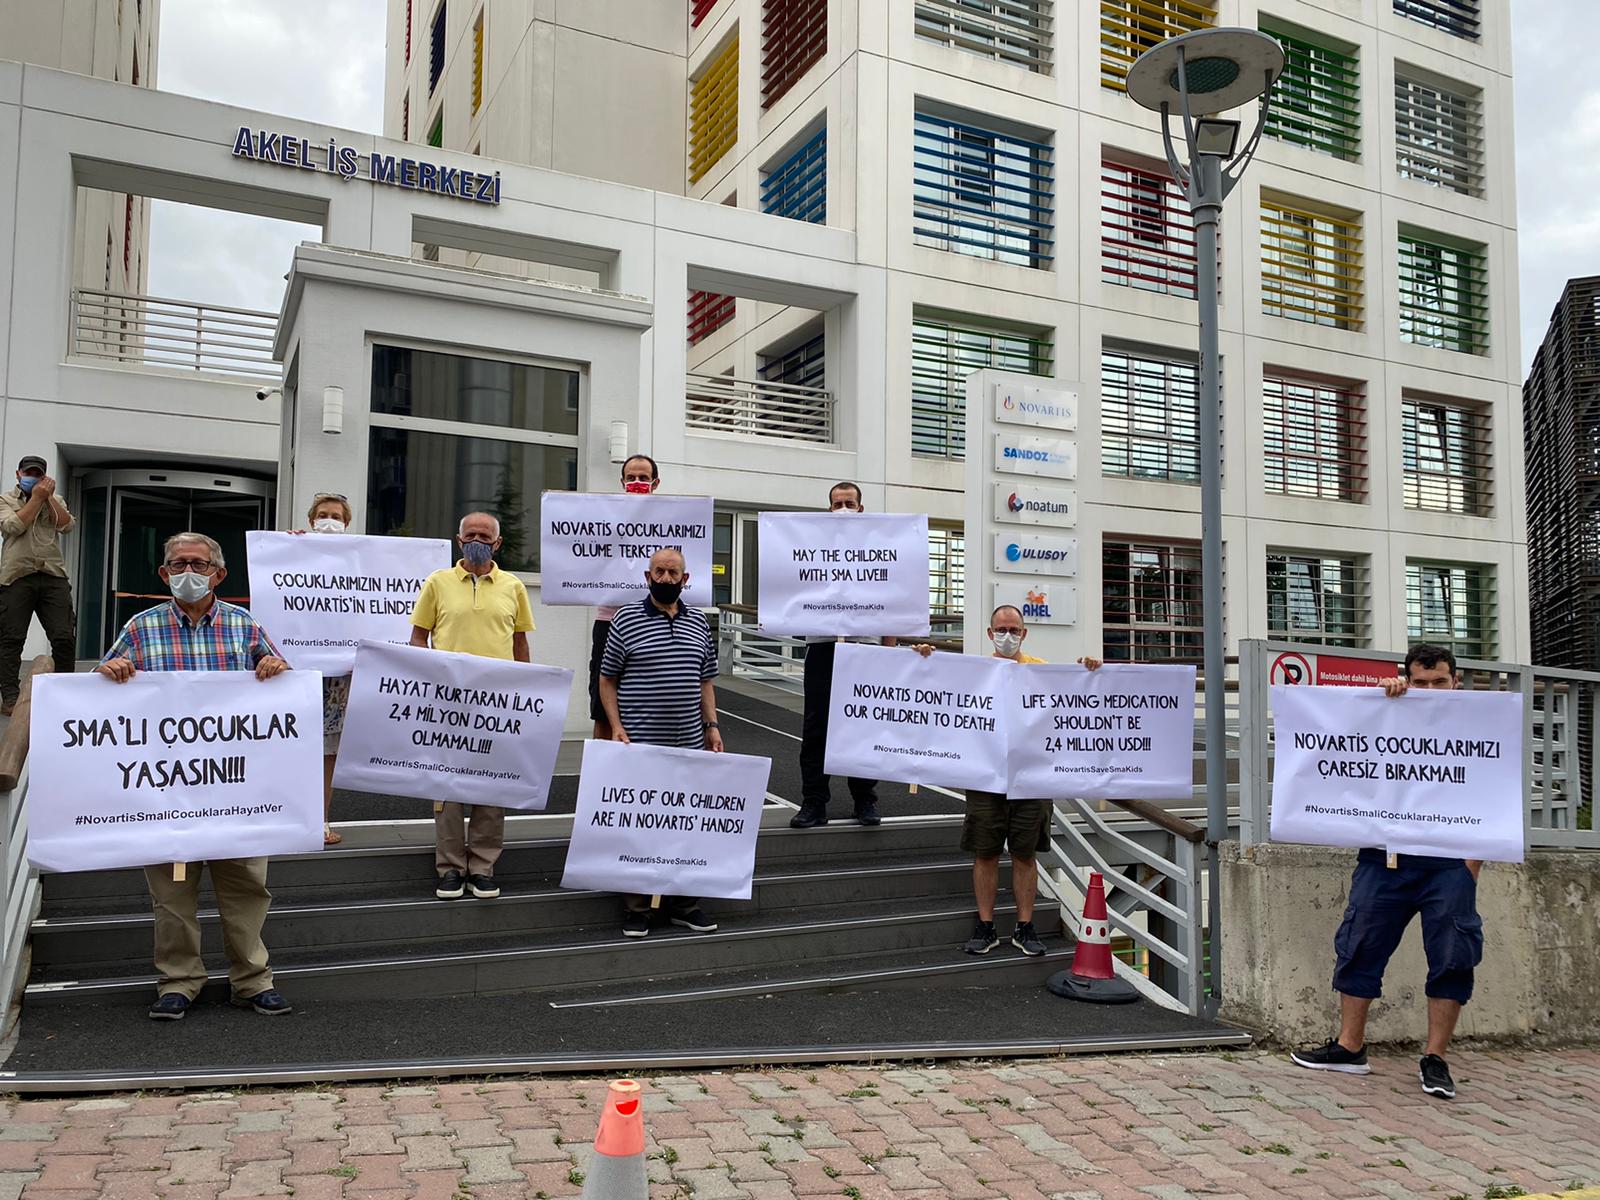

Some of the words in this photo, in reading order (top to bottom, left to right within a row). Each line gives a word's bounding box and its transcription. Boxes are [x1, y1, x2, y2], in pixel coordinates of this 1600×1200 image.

[232, 127, 316, 169] AKEL
[327, 137, 358, 181] İŞ
[369, 152, 500, 206] MERKEZİ
[1019, 402, 1072, 417] NOVARTIS
[1004, 447, 1048, 461] SANDOZ
[1026, 500, 1068, 514] noatum
[551, 520, 611, 536] NOVARTİS
[617, 523, 705, 539] ÇOCUKLARIMIZI
[572, 540, 612, 558] ÖLÜME
[793, 549, 816, 562] MAY
[821, 549, 840, 562] THE
[845, 549, 897, 562] CHILDREN
[1023, 548, 1068, 561] ULUSOY
[273, 573, 381, 592] ÇOCUKLARIMIZIN
[386, 577, 425, 593] HAYA
[800, 568, 827, 581] WITH
[832, 568, 853, 581] SMA
[857, 568, 888, 581] LIVE!!!
[803, 603, 884, 611] #NovartisSaveSmaKids
[1320, 672, 1350, 681] Motosiklet
[1352, 674, 1365, 682] dahil
[379, 677, 431, 696] HAYAT
[435, 685, 508, 709] KURTARAN
[512, 692, 544, 716] İLAÇ
[853, 684, 910, 702] NOVARTIS
[915, 690, 953, 706] DON'T
[957, 694, 993, 710] LEAVE
[1022, 694, 1046, 708] LIFE
[1051, 694, 1100, 708] SAVING
[1104, 695, 1178, 709] MEDICATION
[389, 703, 411, 722] 2,4
[416, 704, 470, 727] MİLYON
[474, 715, 521, 735] DOLAR
[844, 704, 868, 719] OUR
[873, 707, 928, 725] CHILDREN
[934, 712, 950, 727] TO
[954, 715, 995, 732] DEATH!
[1054, 715, 1122, 730] SHOULDN'T
[1128, 716, 1141, 730] BE
[63, 715, 147, 747] SMA'LI
[159, 713, 298, 748] ÇOCUKLAR
[412, 731, 492, 754] OLMAMALI!!!
[873, 745, 961, 760] #NovartisSaveSmaKids
[1045, 737, 1062, 753] 2,4
[1067, 737, 1113, 751] MILLION
[1119, 737, 1151, 751] USD!!!
[1295, 732, 1369, 752] NOVARTİS
[1375, 736, 1500, 758] ÇOCUKLARIMIZI
[117, 756, 246, 791] YAŞASIN!!!
[369, 757, 521, 780] #NovartisSmaliCocuklaraHayatVer
[1318, 759, 1379, 780] ÇARESİZ
[1386, 763, 1466, 784] BIRAKMA!!!
[602, 787, 634, 804] LIVES
[640, 789, 657, 805] OF
[661, 791, 685, 807] OUR
[690, 793, 745, 812] CHILDREN
[75, 803, 283, 826] #NovartisSmaliCocuklaraHayatVer
[591, 811, 615, 827] ARE
[619, 813, 632, 828] IN
[636, 813, 698, 831] NOVARTIS'
[701, 817, 744, 834] HANDS!
[1305, 804, 1482, 825] #NovartisSmaliCocuklaraHayatVer
[618, 855, 707, 867] #NovartisSaveSmaKids
